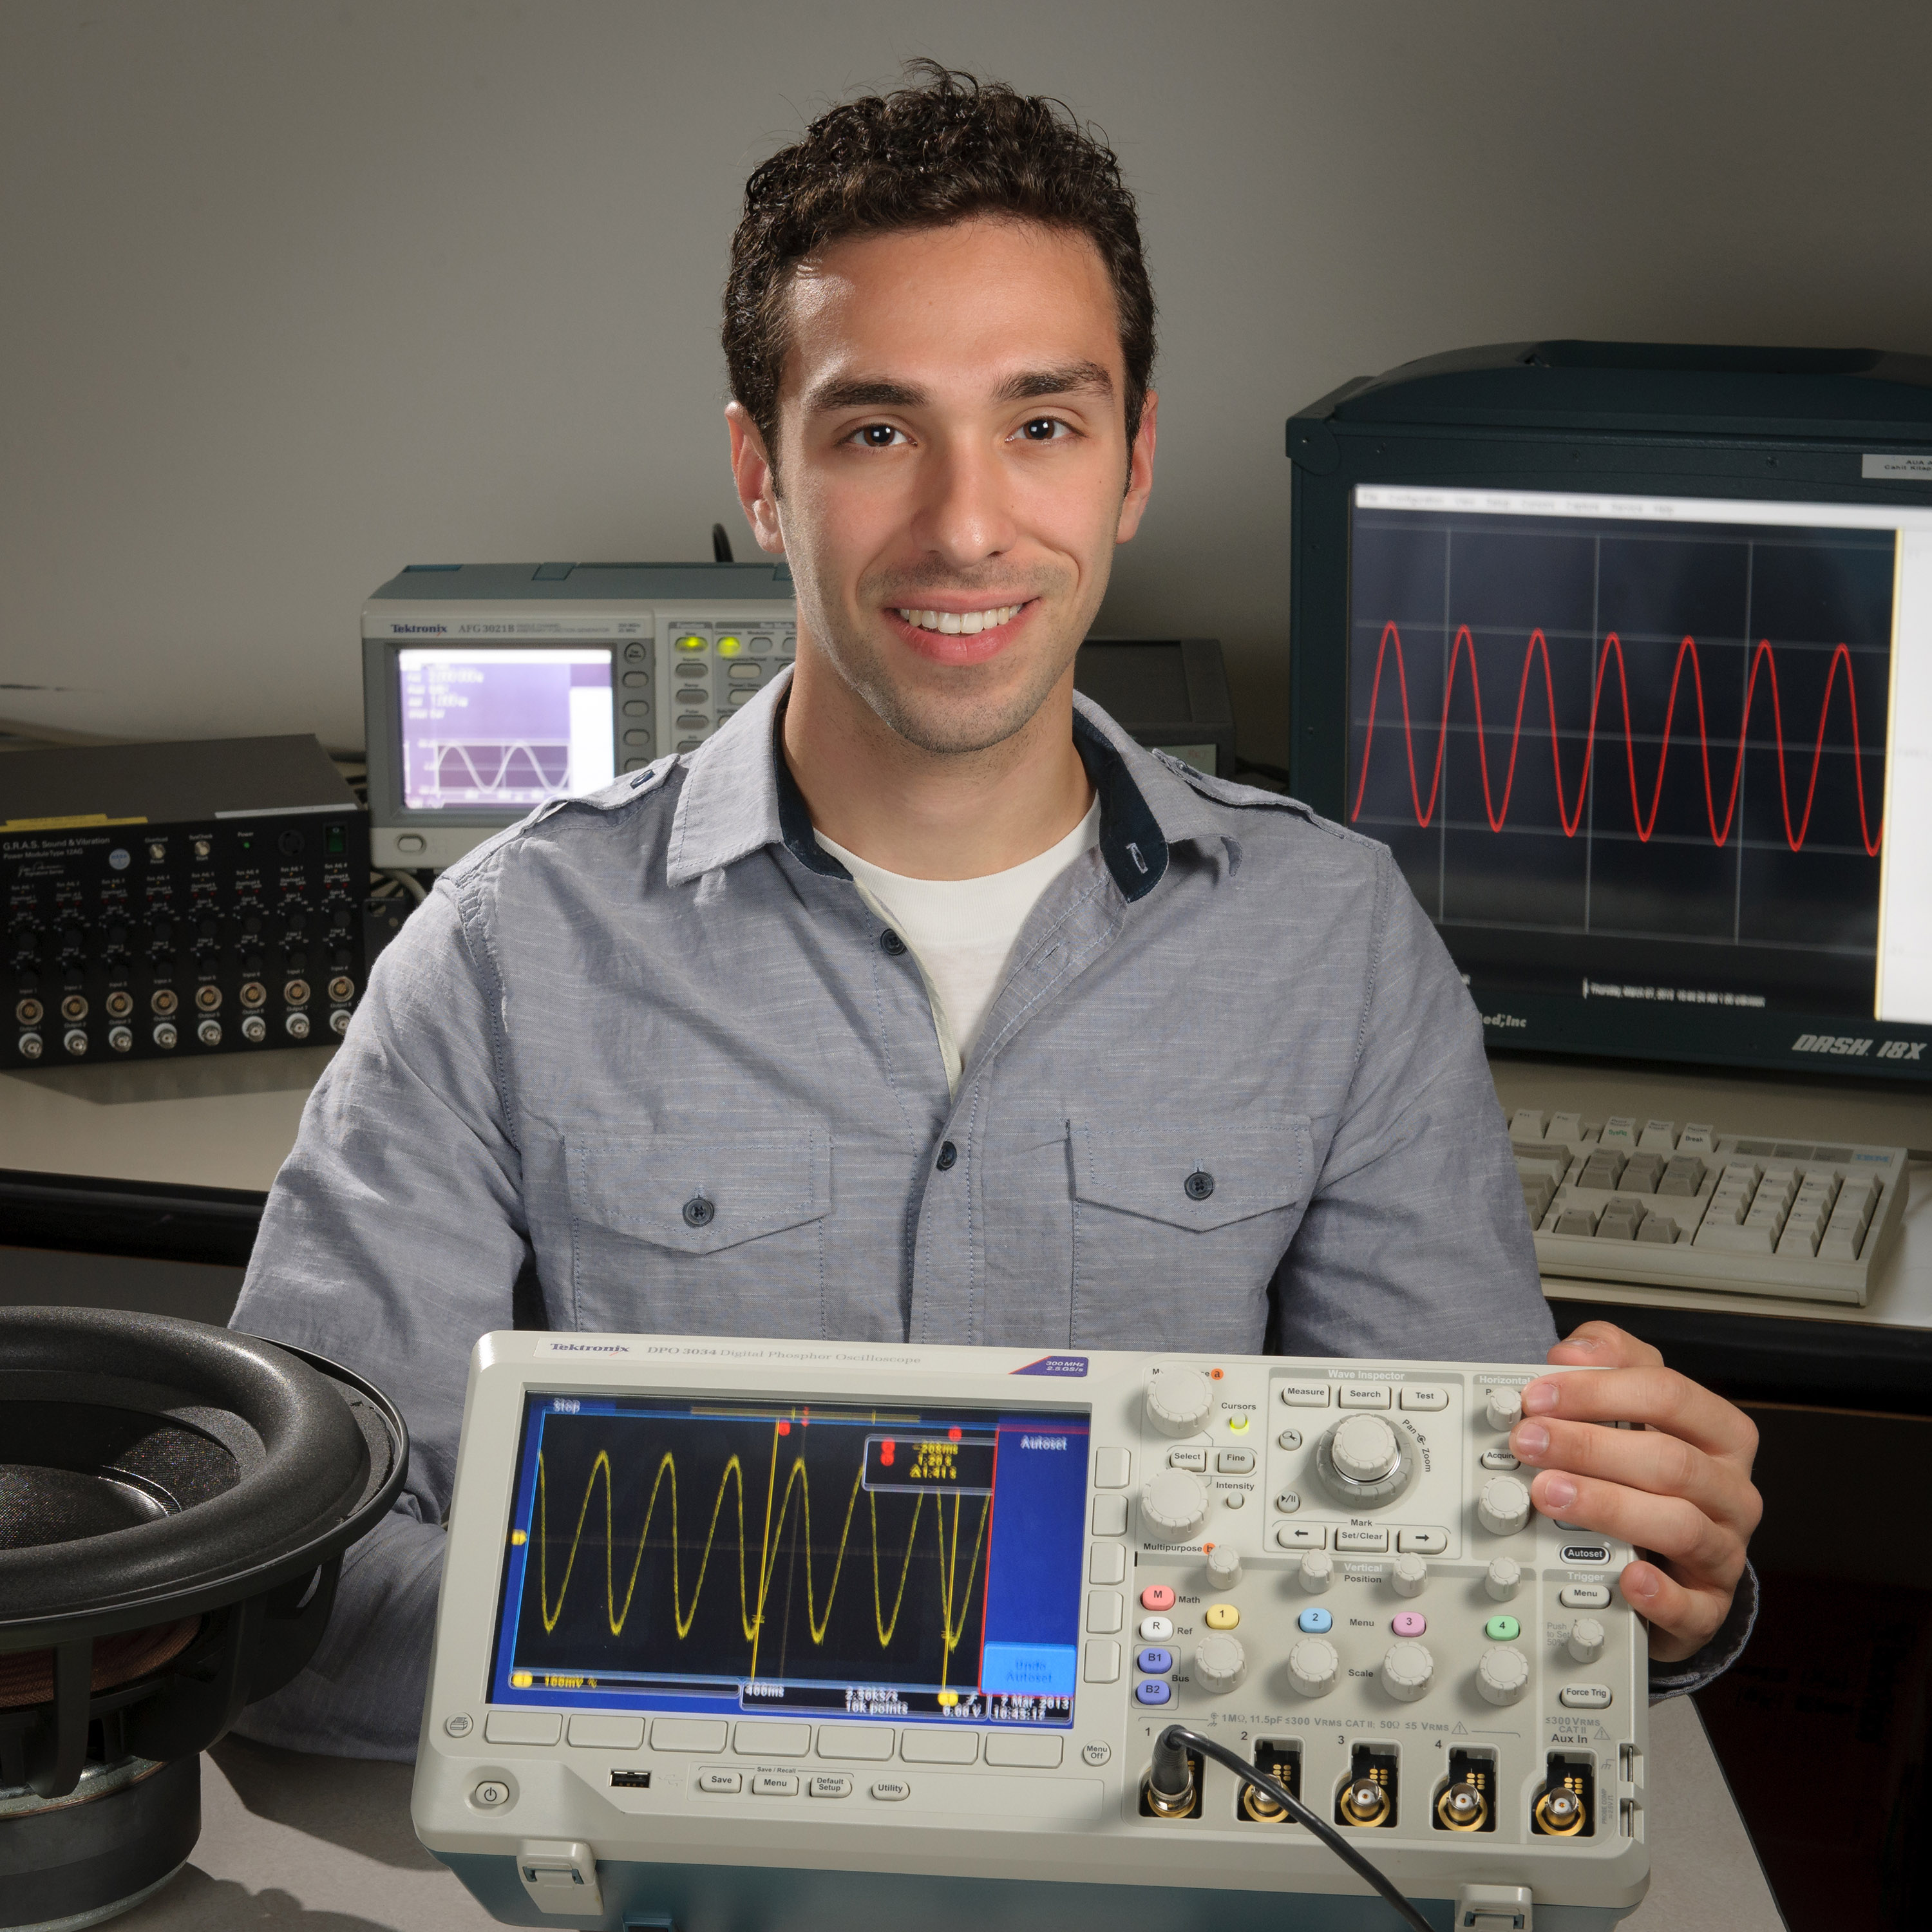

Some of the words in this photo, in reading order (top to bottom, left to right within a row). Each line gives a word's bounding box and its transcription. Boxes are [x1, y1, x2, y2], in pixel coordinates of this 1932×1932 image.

[391, 623, 447, 634] Tektronix
[459, 624, 480, 633] AFG
[483, 624, 515, 634] 3021B
[3, 840, 39, 851] G.R.A.S.
[42, 838, 66, 849] Sound
[69, 838, 75, 847] &
[75, 837, 110, 846] Vibration
[50, 849, 64, 858] Type
[1792, 1034, 1873, 1056] DASH
[1876, 1041, 1927, 1060] 18X
[1608, 1129, 1627, 1137] SysRq
[1855, 1153, 1889, 1162] IBM
[550, 1343, 629, 1353] Tektronix
[683, 1347, 717, 1356] 3034
[720, 1349, 763, 1358] Digital
[768, 1350, 832, 1361] Phosphor
[835, 1353, 922, 1364] Oscilloscope
[1329, 1370, 1355, 1378] Wave
[1358, 1370, 1405, 1381] Inspector
[1479, 1376, 1531, 1385] Horizontal
[1287, 1388, 1325, 1396] Measure
[553, 1397, 580, 1414] Stop
[1402, 1419, 1417, 1434] Pan
[1020, 1435, 1067, 1451] Autoset
[1422, 1448, 1431, 1472] Zoom
[1487, 1452, 1516, 1460] Acquire
[1216, 1482, 1255, 1491] Intensity
[1144, 1543, 1202, 1553] Multipurpose
[1567, 1549, 1603, 1558] Autoset
[1344, 1563, 1382, 1572] Vertical
[1344, 1575, 1381, 1583] Position
[1567, 1571, 1605, 1582] Trigger
[1153, 1590, 1162, 1598] M
[1312, 1613, 1318, 1622] 2
[1406, 1617, 1412, 1625] 3
[1153, 1622, 1160, 1630] R
[1350, 1618, 1374, 1627] Menu
[1547, 1622, 1567, 1630] Push
[1547, 1638, 1564, 1647] 50%
[1016, 1660, 1046, 1671] Undo
[1007, 1671, 1052, 1683] Autoset
[744, 1681, 784, 1698] 400ms
[1566, 1688, 1589, 1696] Force
[1591, 1689, 1606, 1698] Trig
[1011, 1693, 1034, 1708] Mar
[1039, 1694, 1070, 1710] 2013
[846, 1700, 866, 1714] 10k
[870, 1701, 908, 1716] points
[1222, 1714, 1247, 1724] 1MΩ,
[1250, 1715, 1283, 1726] 11.5pF
[1285, 1717, 1310, 1726] ≤300
[1314, 1718, 1341, 1727] VRMS
[1345, 1719, 1365, 1728] CAT
[1380, 1721, 1400, 1729] 50Ω
[1421, 1723, 1449, 1732] VRMS
[1546, 1716, 1570, 1725] ≤300
[1572, 1717, 1600, 1727] VRMS
[1145, 1727, 1150, 1736] 1
[1241, 1731, 1248, 1740] 2
[1338, 1736, 1345, 1745] 3
[1551, 1734, 1574, 1743] Aux
[1578, 1735, 1587, 1743] In
[1435, 1740, 1443, 1749] 4
[711, 1776, 732, 1784] Save
[817, 1777, 844, 1785] Default
[819, 1784, 841, 1792] Setup
[878, 1784, 903, 1794] Utility
